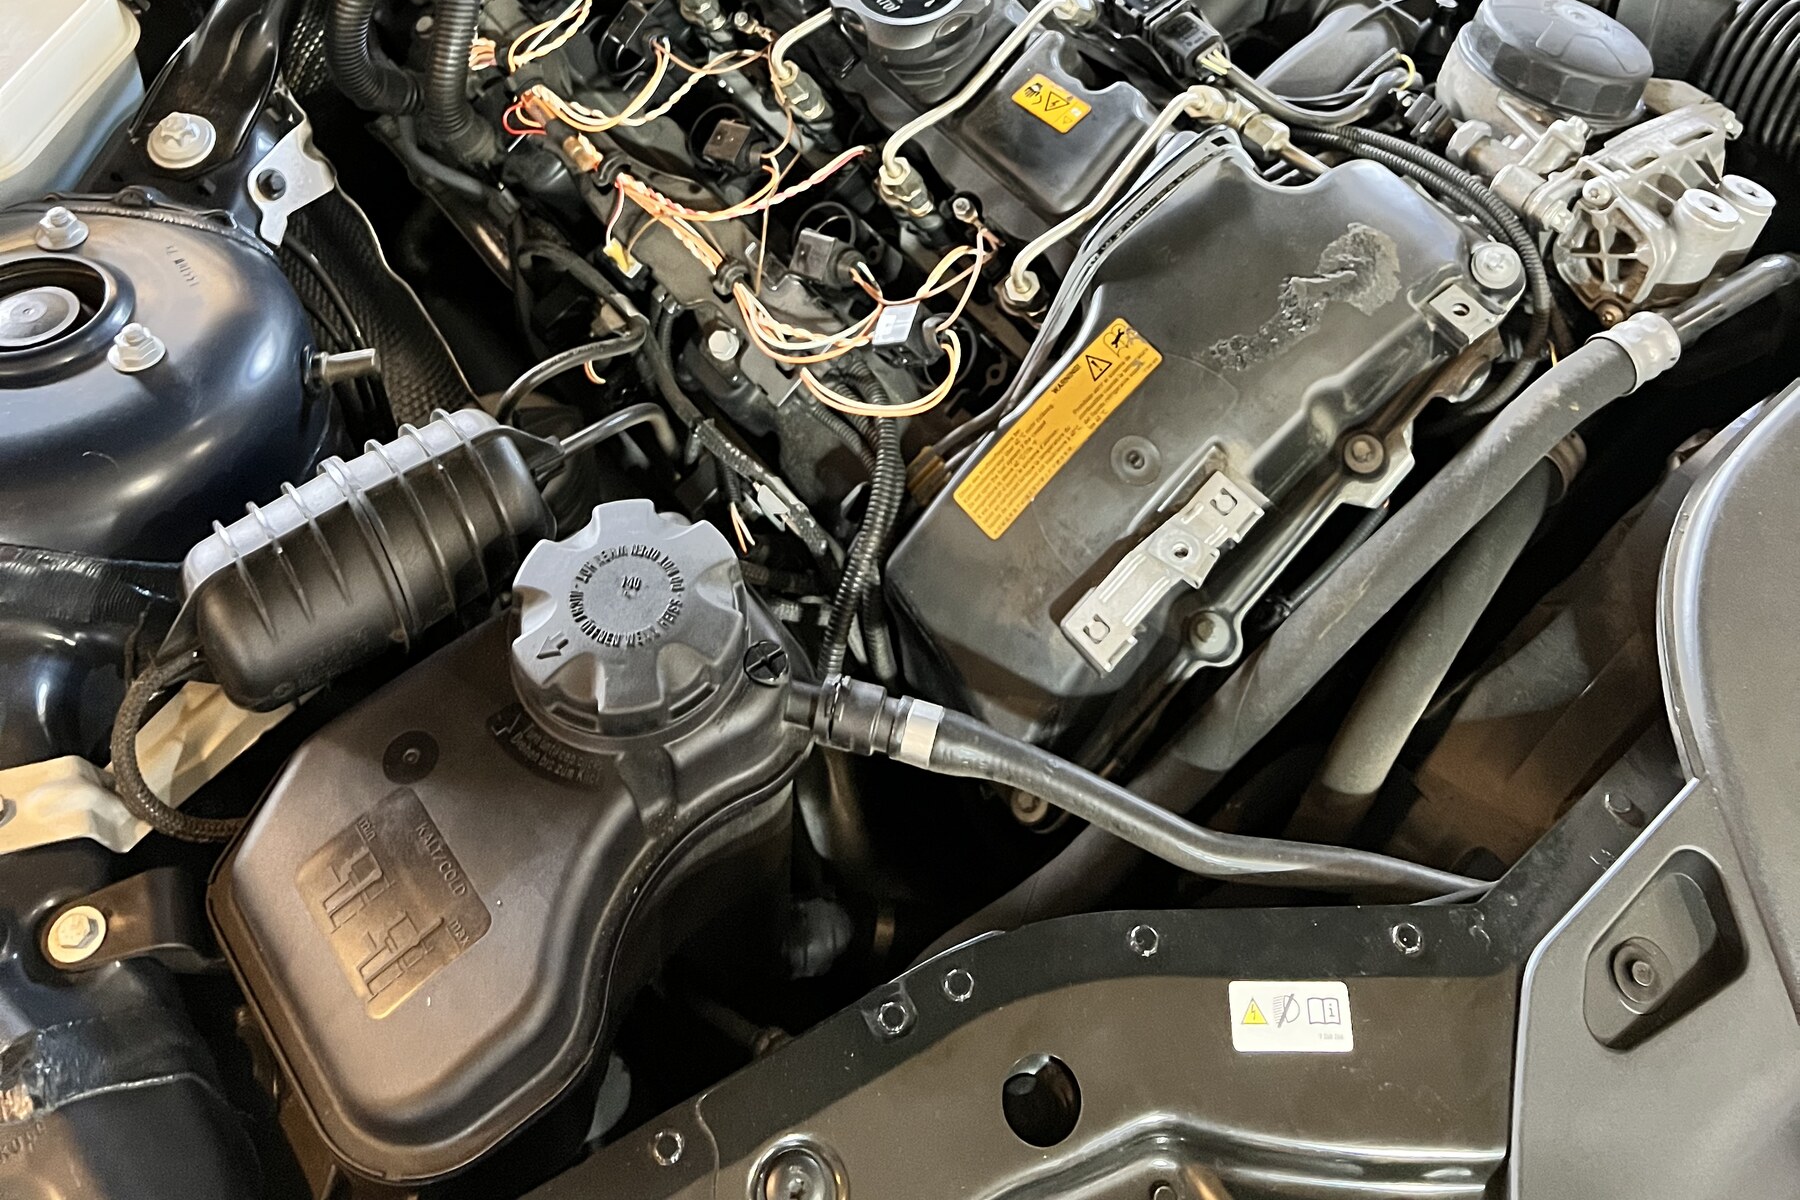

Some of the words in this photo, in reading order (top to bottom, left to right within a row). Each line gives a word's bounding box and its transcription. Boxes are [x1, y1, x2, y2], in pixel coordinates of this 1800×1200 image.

[358, 817, 378, 842] min
[416, 823, 467, 897] KALT/COLD
[451, 918, 472, 947] max
